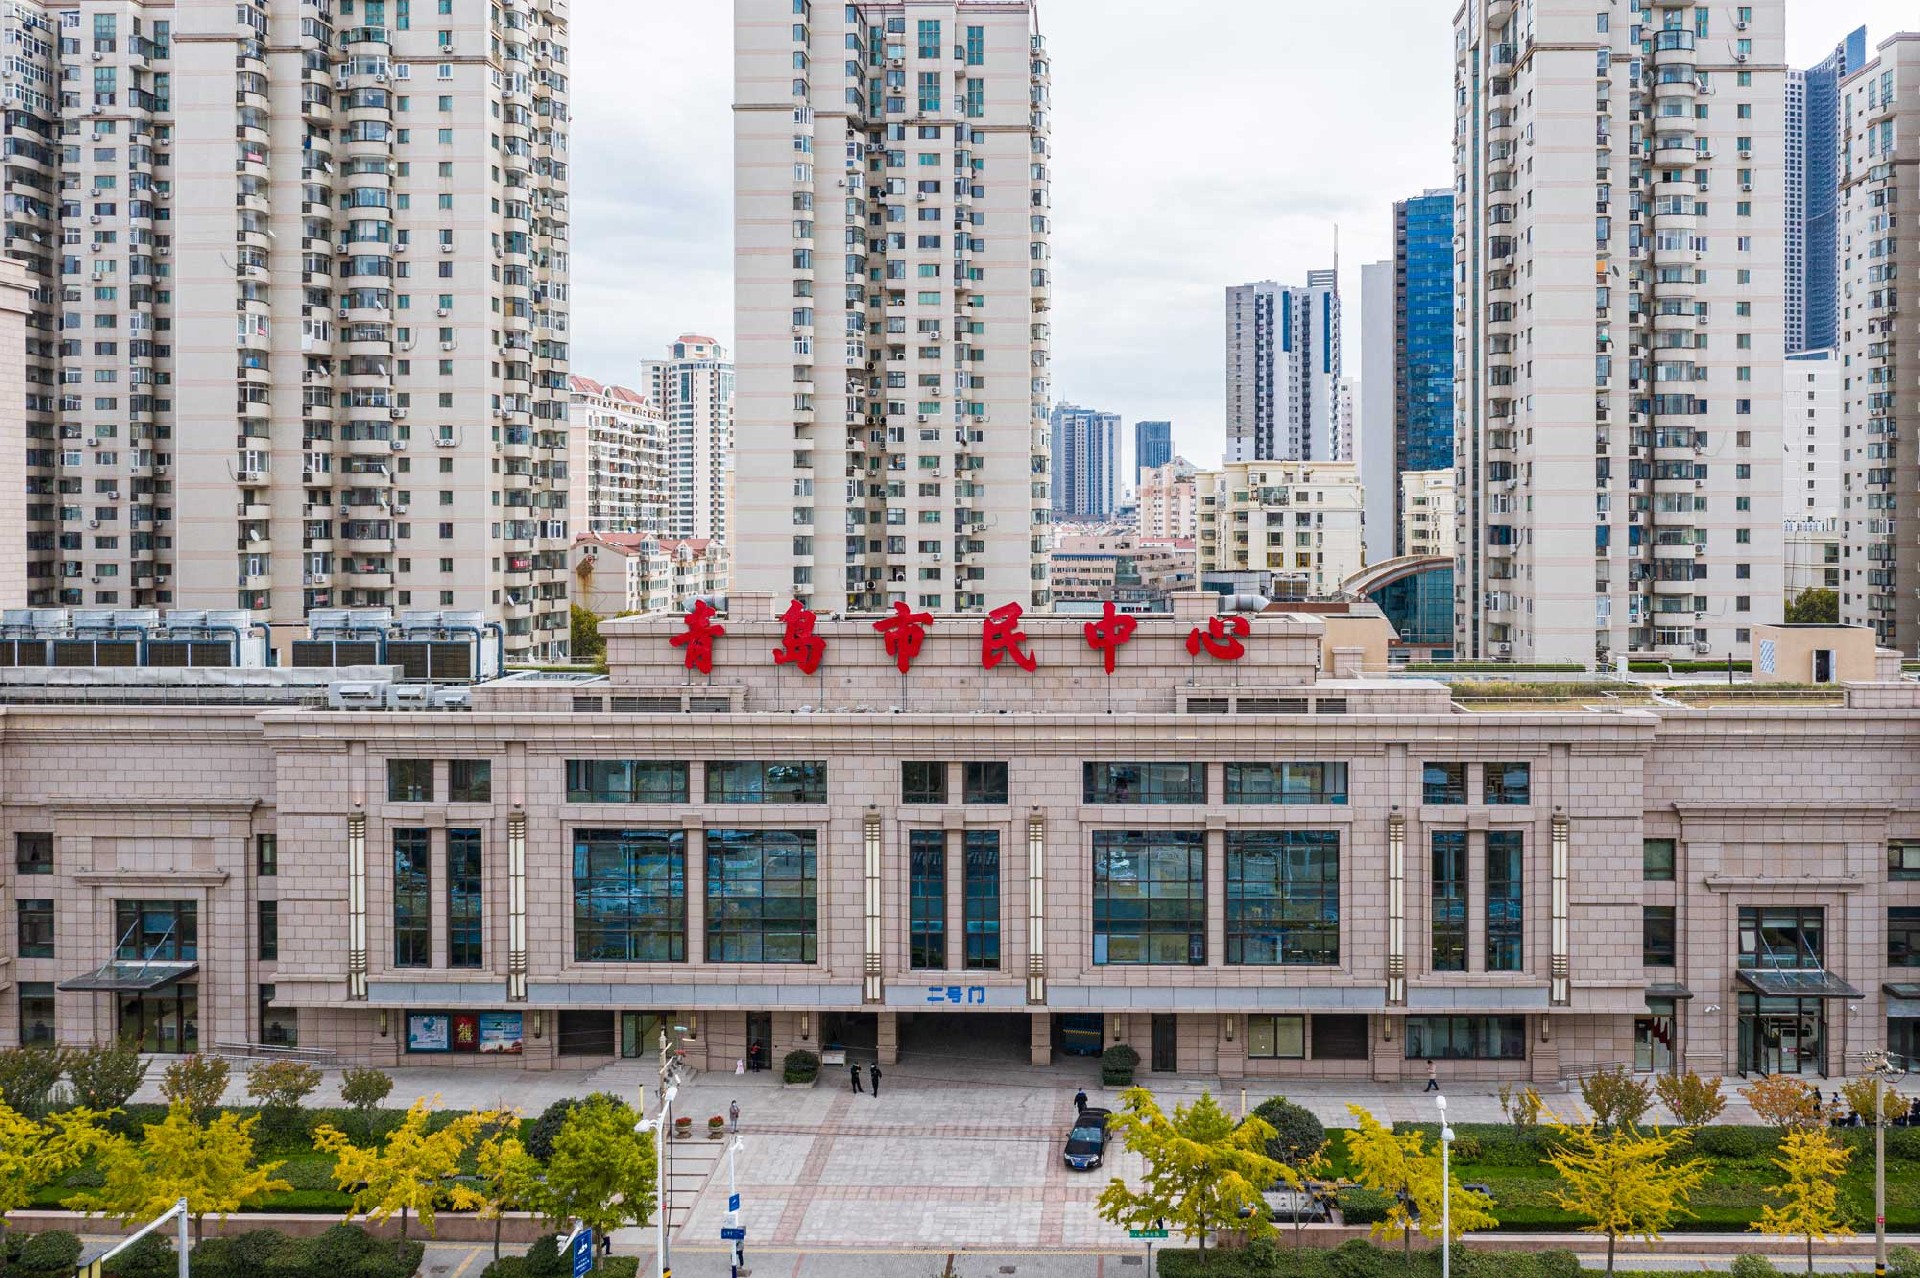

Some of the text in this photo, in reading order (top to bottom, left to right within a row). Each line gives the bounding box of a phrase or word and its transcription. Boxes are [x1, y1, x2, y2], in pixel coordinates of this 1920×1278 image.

[669, 599, 1251, 675] 青岛市民中心
[927, 986, 985, 1004] 二号门
